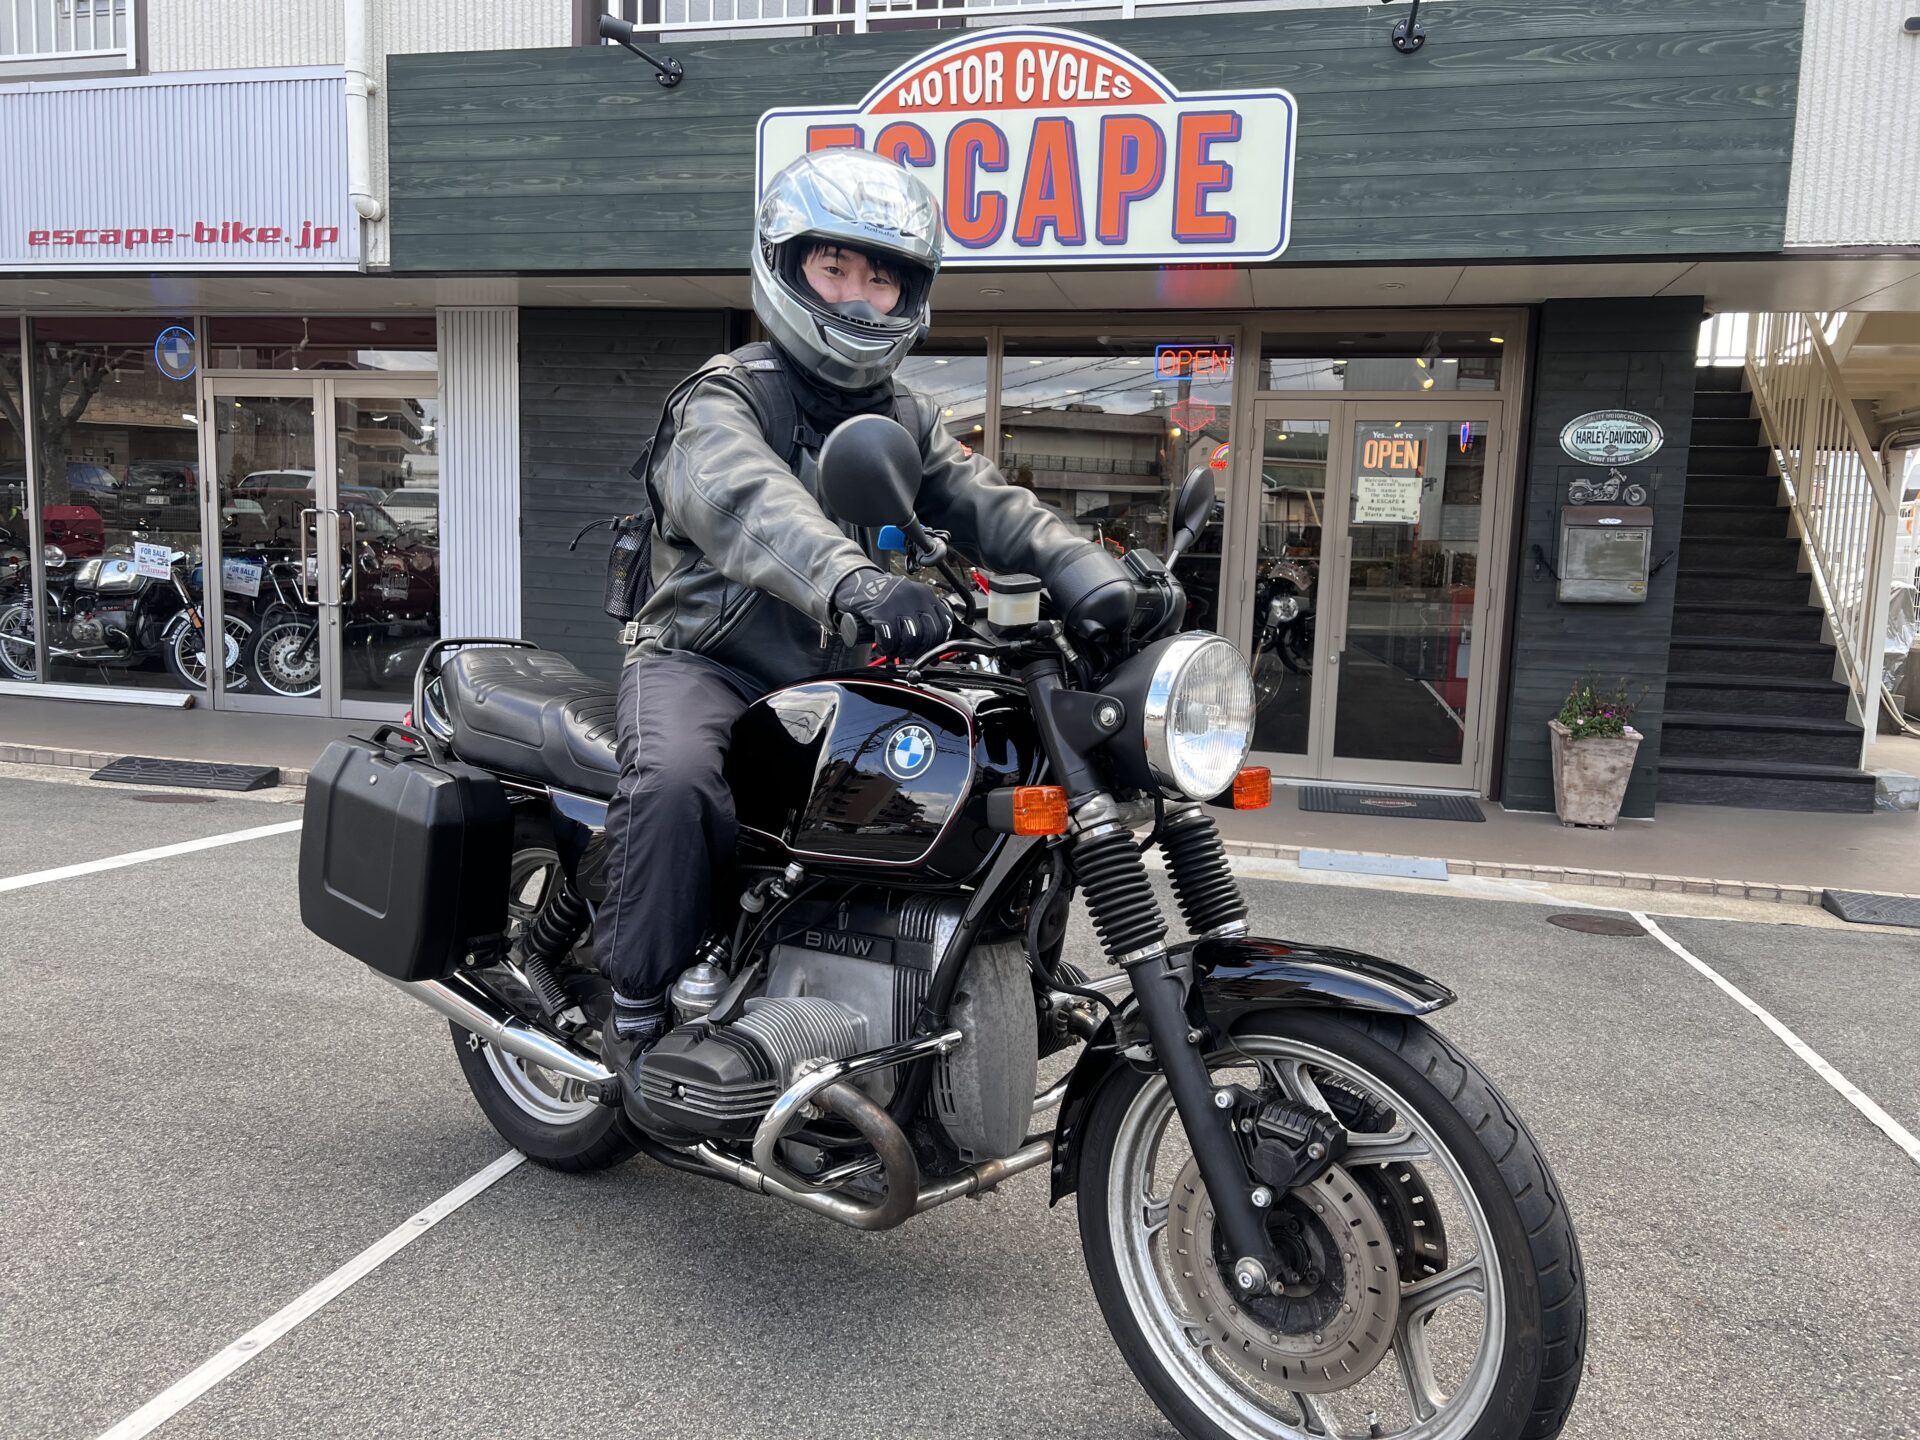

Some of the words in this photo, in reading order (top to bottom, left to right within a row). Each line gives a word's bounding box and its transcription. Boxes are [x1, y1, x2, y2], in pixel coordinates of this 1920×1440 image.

[898, 51, 1004, 107] MOTOR
[1015, 48, 1133, 102] CYCLES
[806, 110, 1242, 248] CAPE
[28, 221, 339, 249] escape-bike.jp
[1160, 350, 1228, 375] OPEN
[1576, 430, 1648, 444] HARLEY-DAVIDSON
[1363, 440, 1419, 469] OPEN
[141, 547, 152, 556] FOR
[152, 548, 166, 558] SALE
[240, 568, 256, 576] SALE
[895, 728, 931, 746] BMW
[805, 930, 874, 956] BMW
